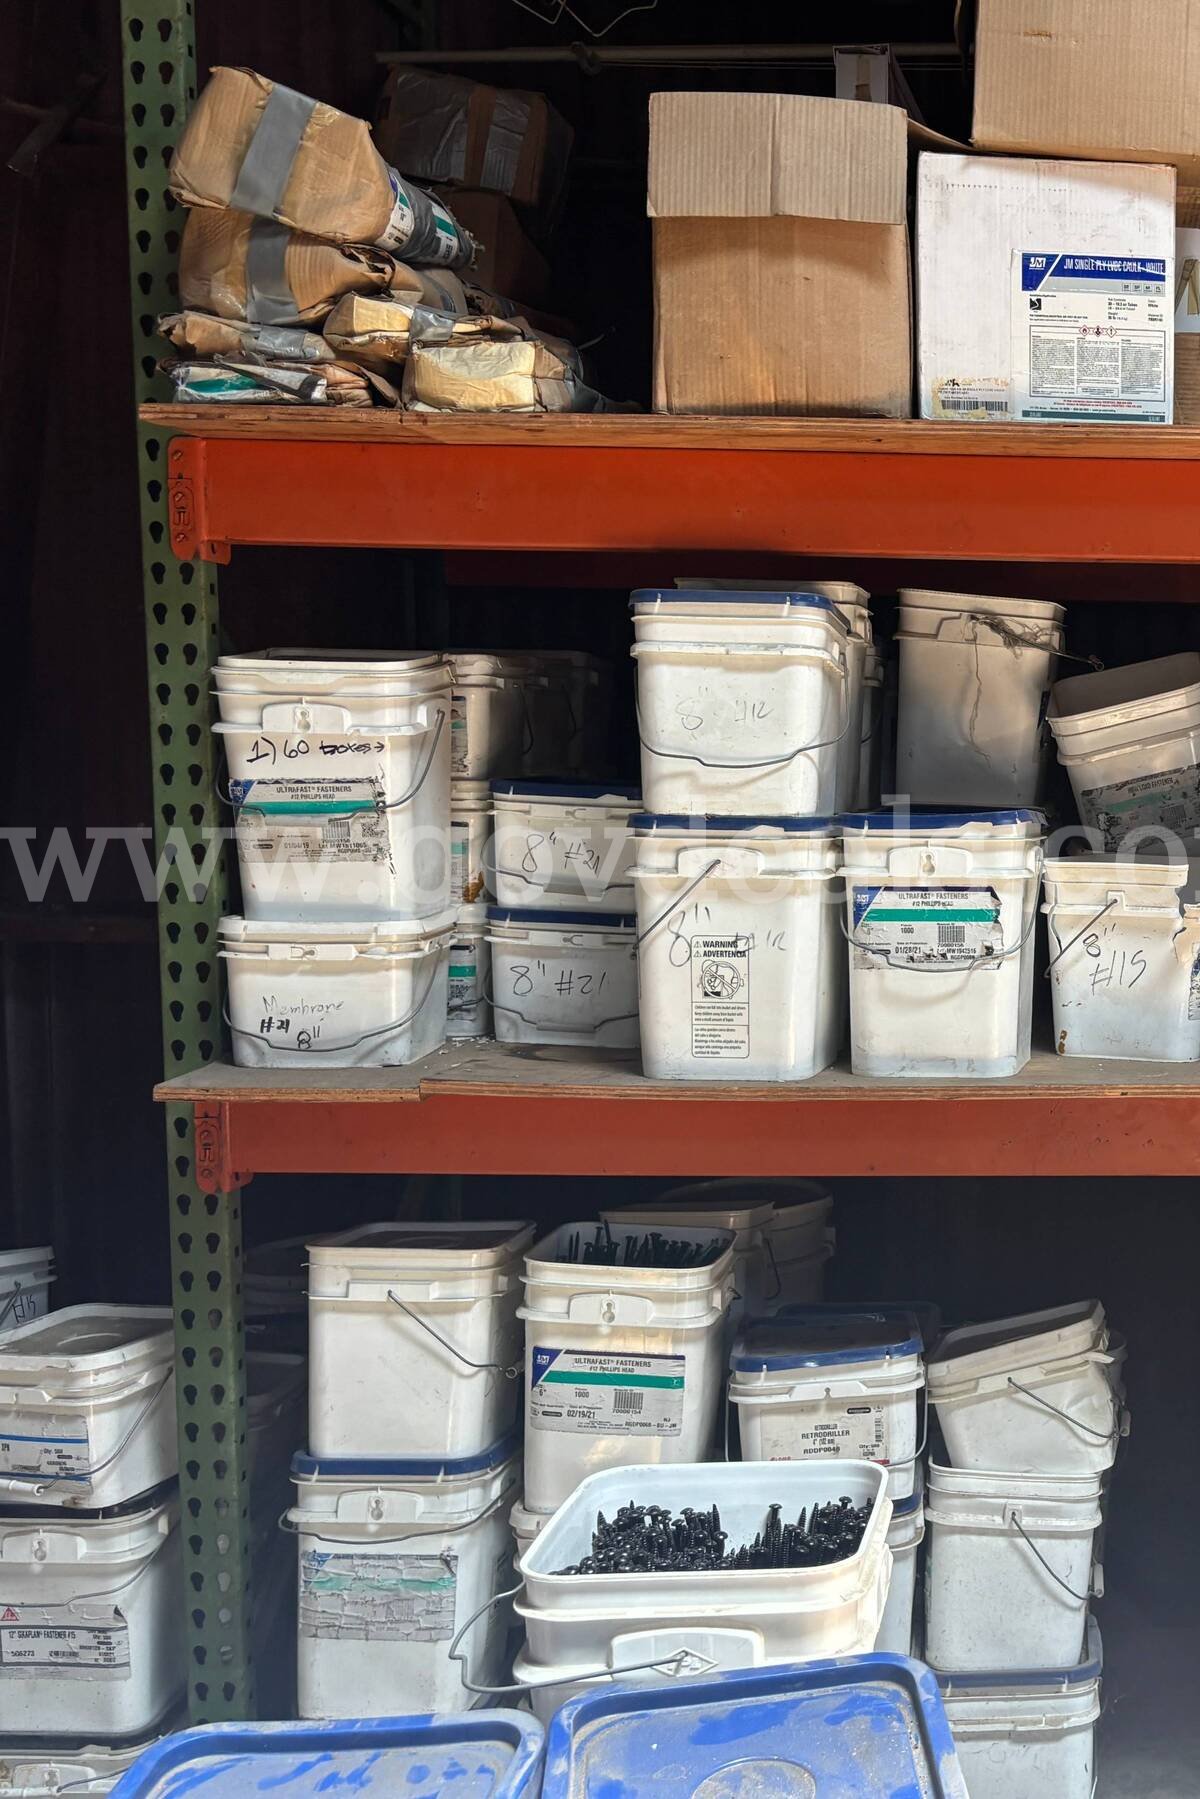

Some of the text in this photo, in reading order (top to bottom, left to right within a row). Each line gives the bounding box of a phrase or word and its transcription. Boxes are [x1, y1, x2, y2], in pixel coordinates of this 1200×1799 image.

[1063, 258, 1073, 269] JM
[1074, 259, 1094, 271] SINGLE
[283, 739, 310, 759] 60
[317, 785, 352, 793] FASTENERS
[668, 903, 712, 967] 8"
[1083, 923, 1116, 957] 8"
[703, 941, 738, 949] WARNING
[703, 950, 747, 958] ADVERTENCIA
[510, 959, 607, 996] 8" #21
[1089, 950, 1146, 995] #15
[616, 1359, 652, 1368] FASTENERS
[567, 1410, 596, 1419] 02/19/21
[8, 1630, 17, 1639] 12"
[43, 1631, 67, 1639] FASTENER
